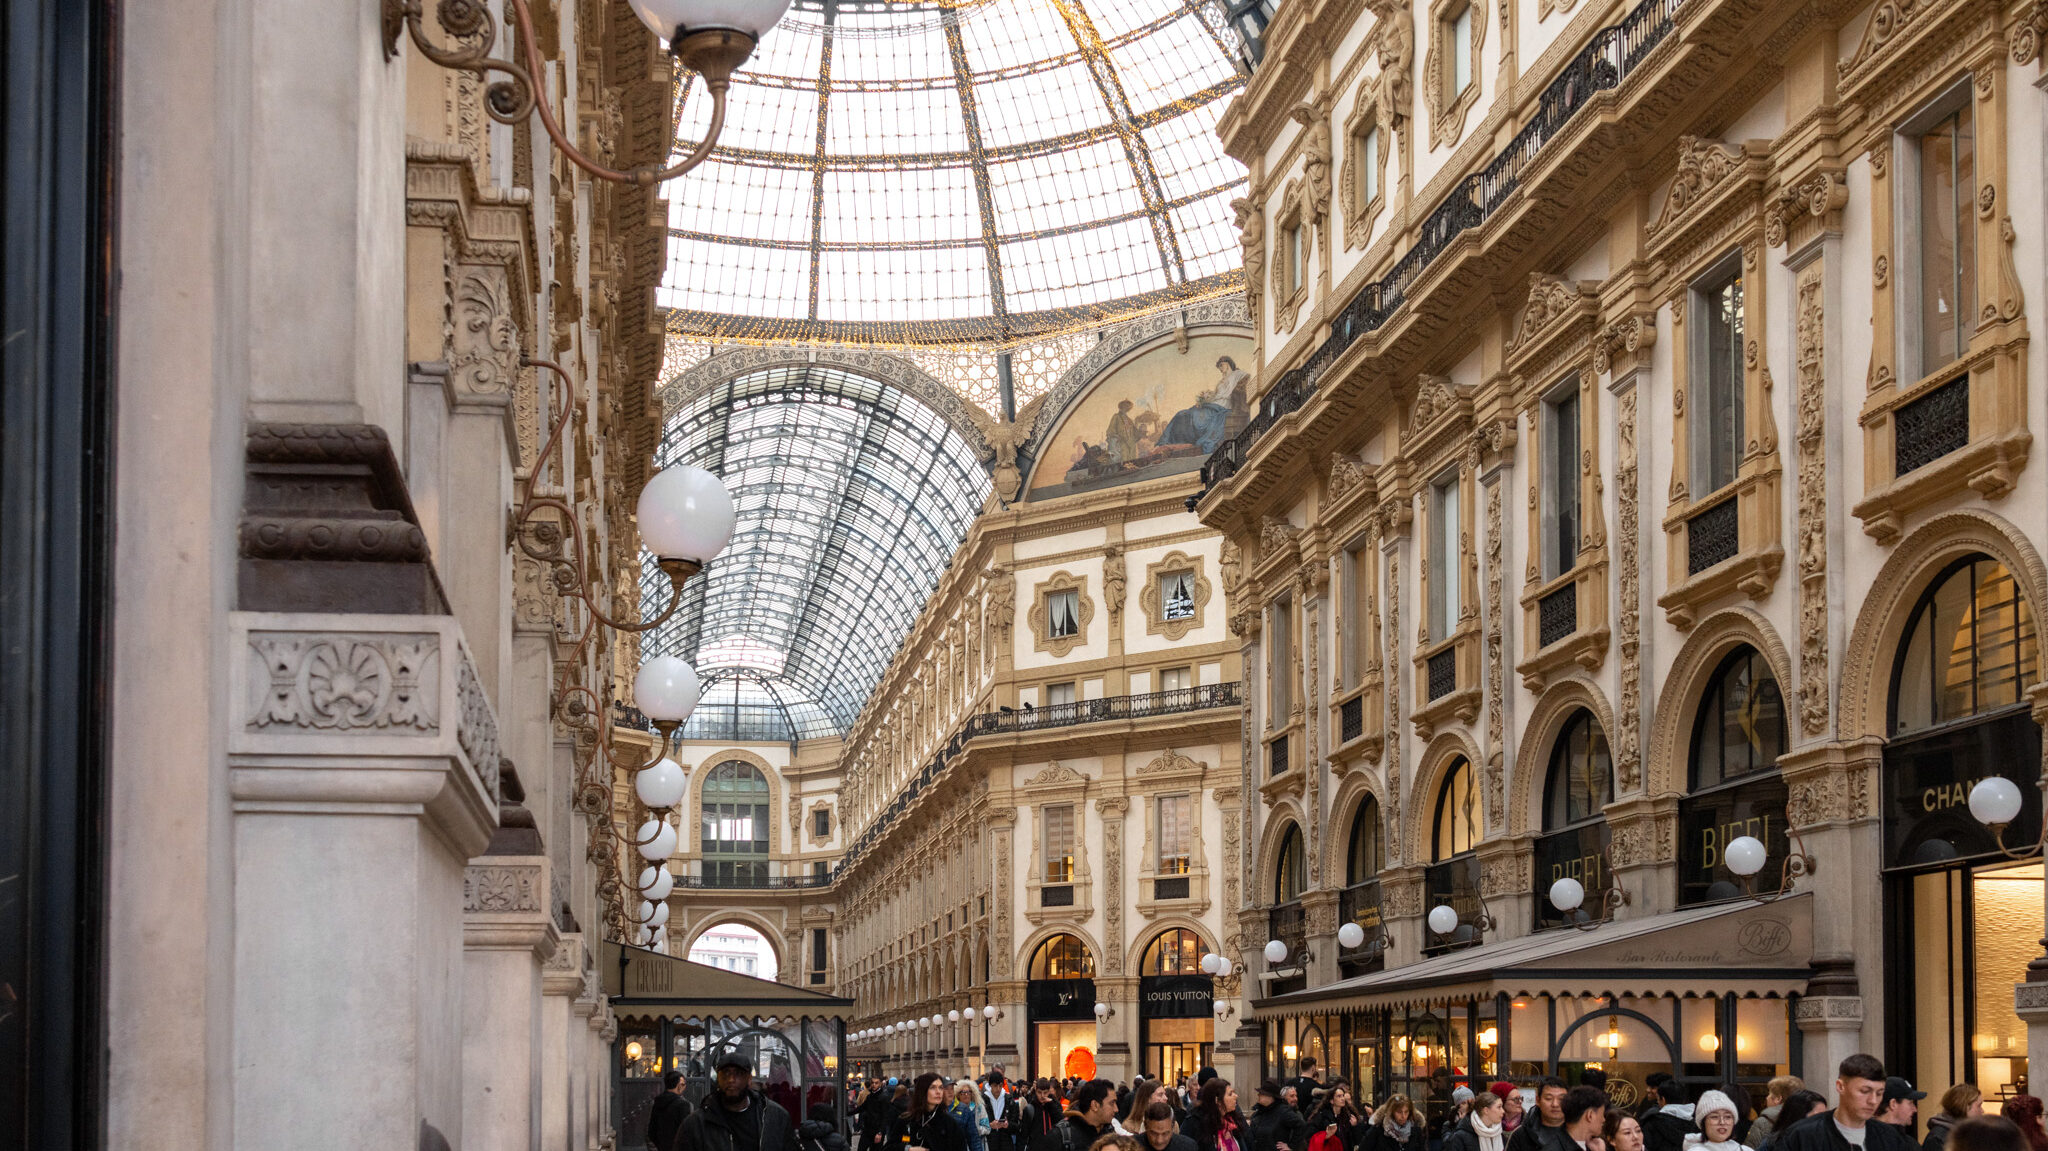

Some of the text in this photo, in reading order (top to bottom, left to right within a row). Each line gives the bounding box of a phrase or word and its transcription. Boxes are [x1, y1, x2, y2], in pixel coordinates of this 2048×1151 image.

[1744, 922, 1785, 951] Biffi
[1616, 950, 1646, 964] Bar
[636, 959, 673, 993] CRACCO
[1147, 990, 1211, 1001] LOUIS VUITTON
